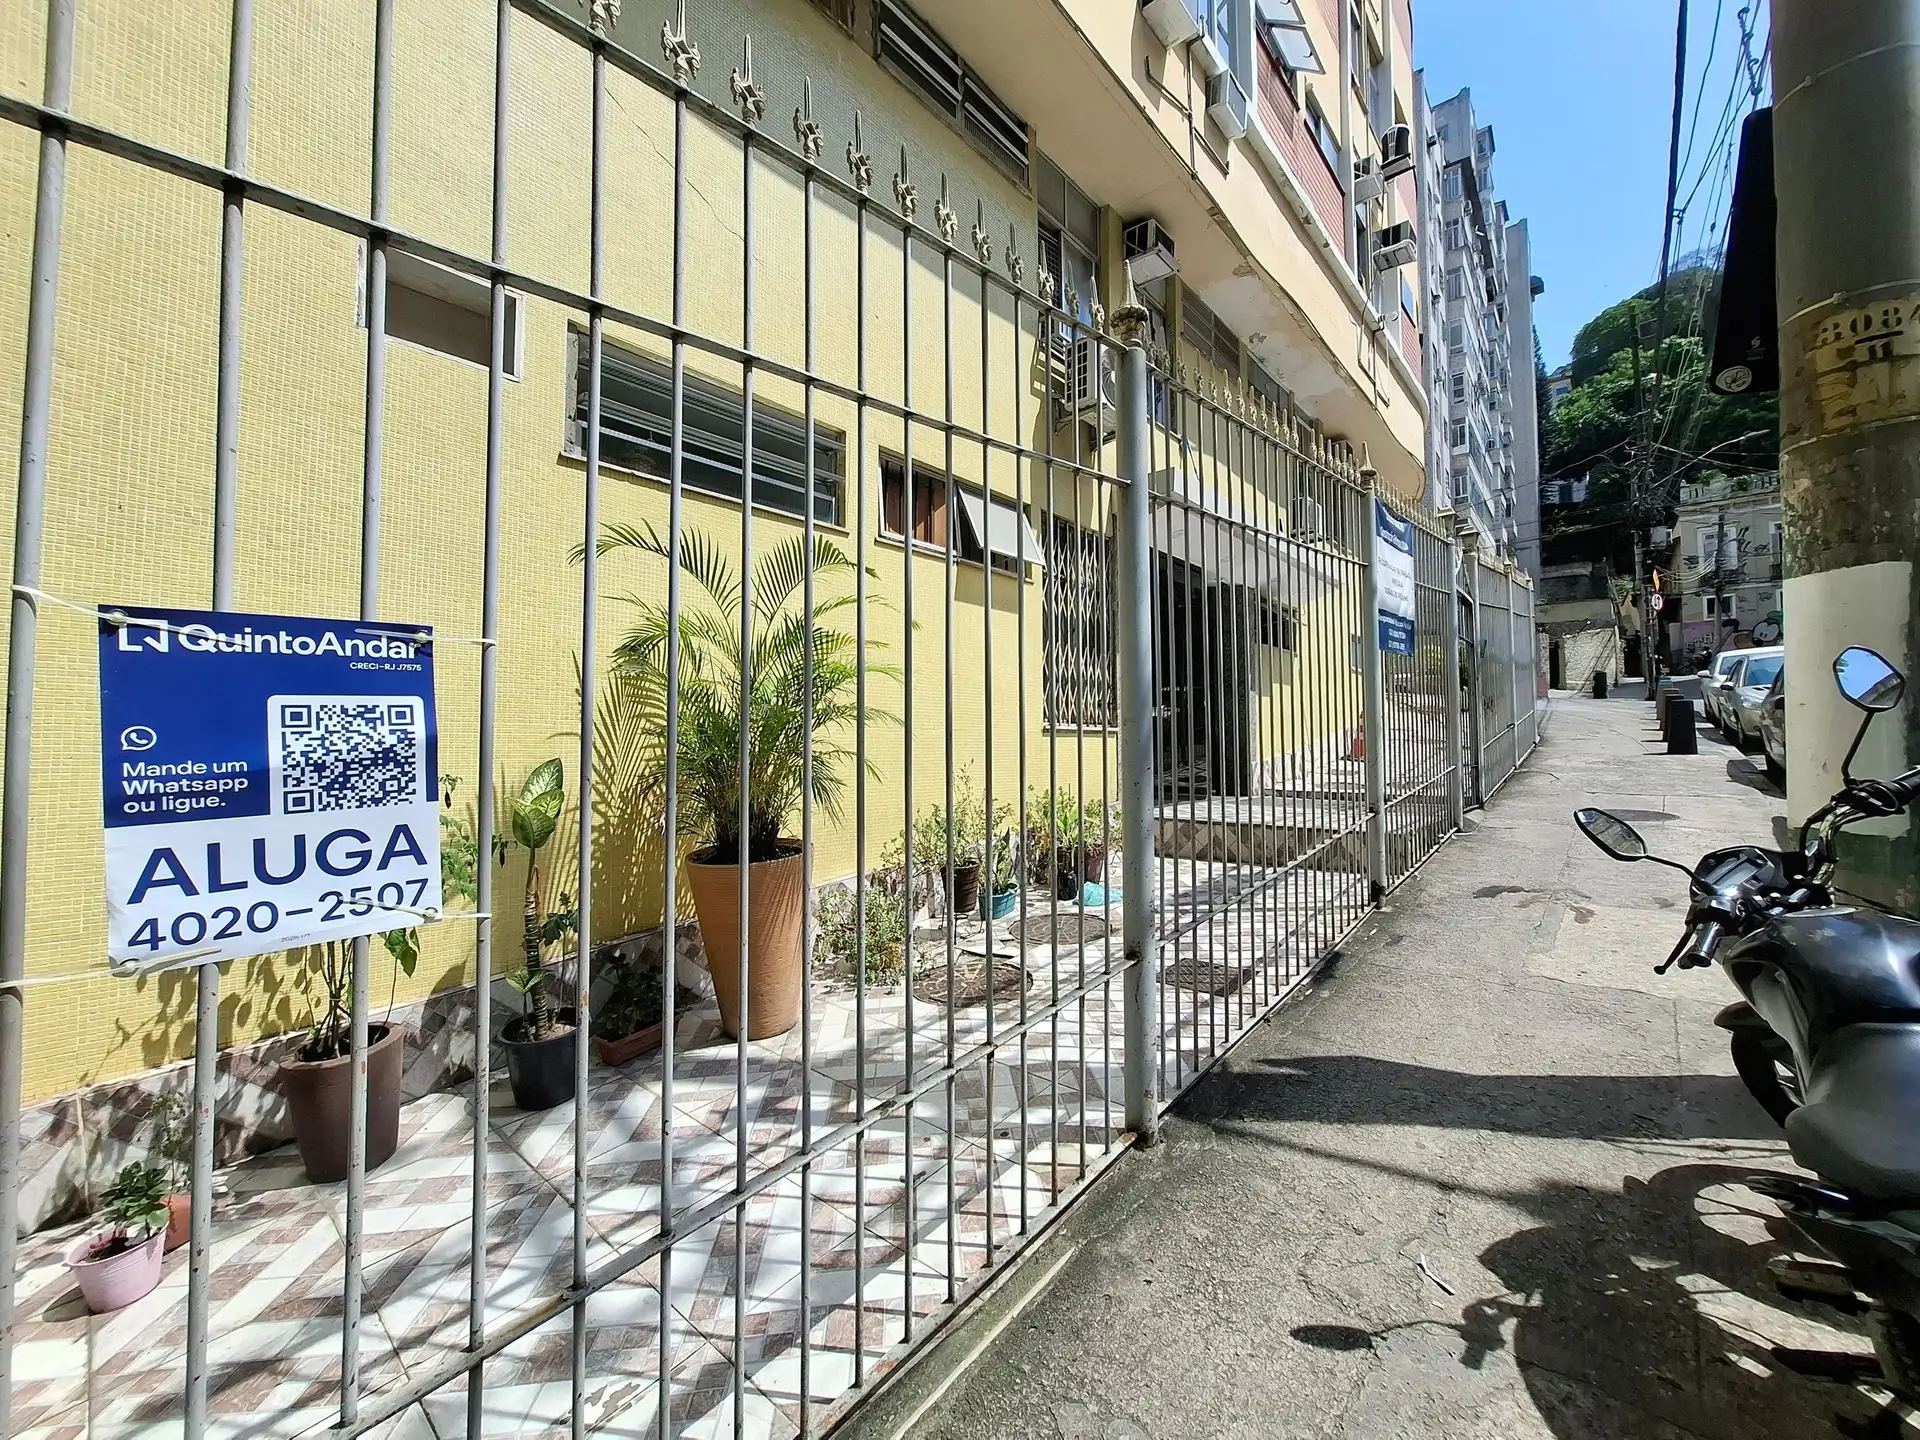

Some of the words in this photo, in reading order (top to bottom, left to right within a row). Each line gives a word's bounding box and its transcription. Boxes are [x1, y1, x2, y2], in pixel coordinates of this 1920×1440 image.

[177, 623, 421, 660] QuintoAndar
[396, 663, 422, 672] J7575
[122, 759, 208, 777] Mande
[213, 758, 248, 773] um
[122, 776, 249, 796] Whatsapp
[123, 798, 156, 814] ou
[161, 793, 227, 812] ligue.
[126, 823, 428, 905] ALUGA
[127, 877, 429, 952] 4020-2507
